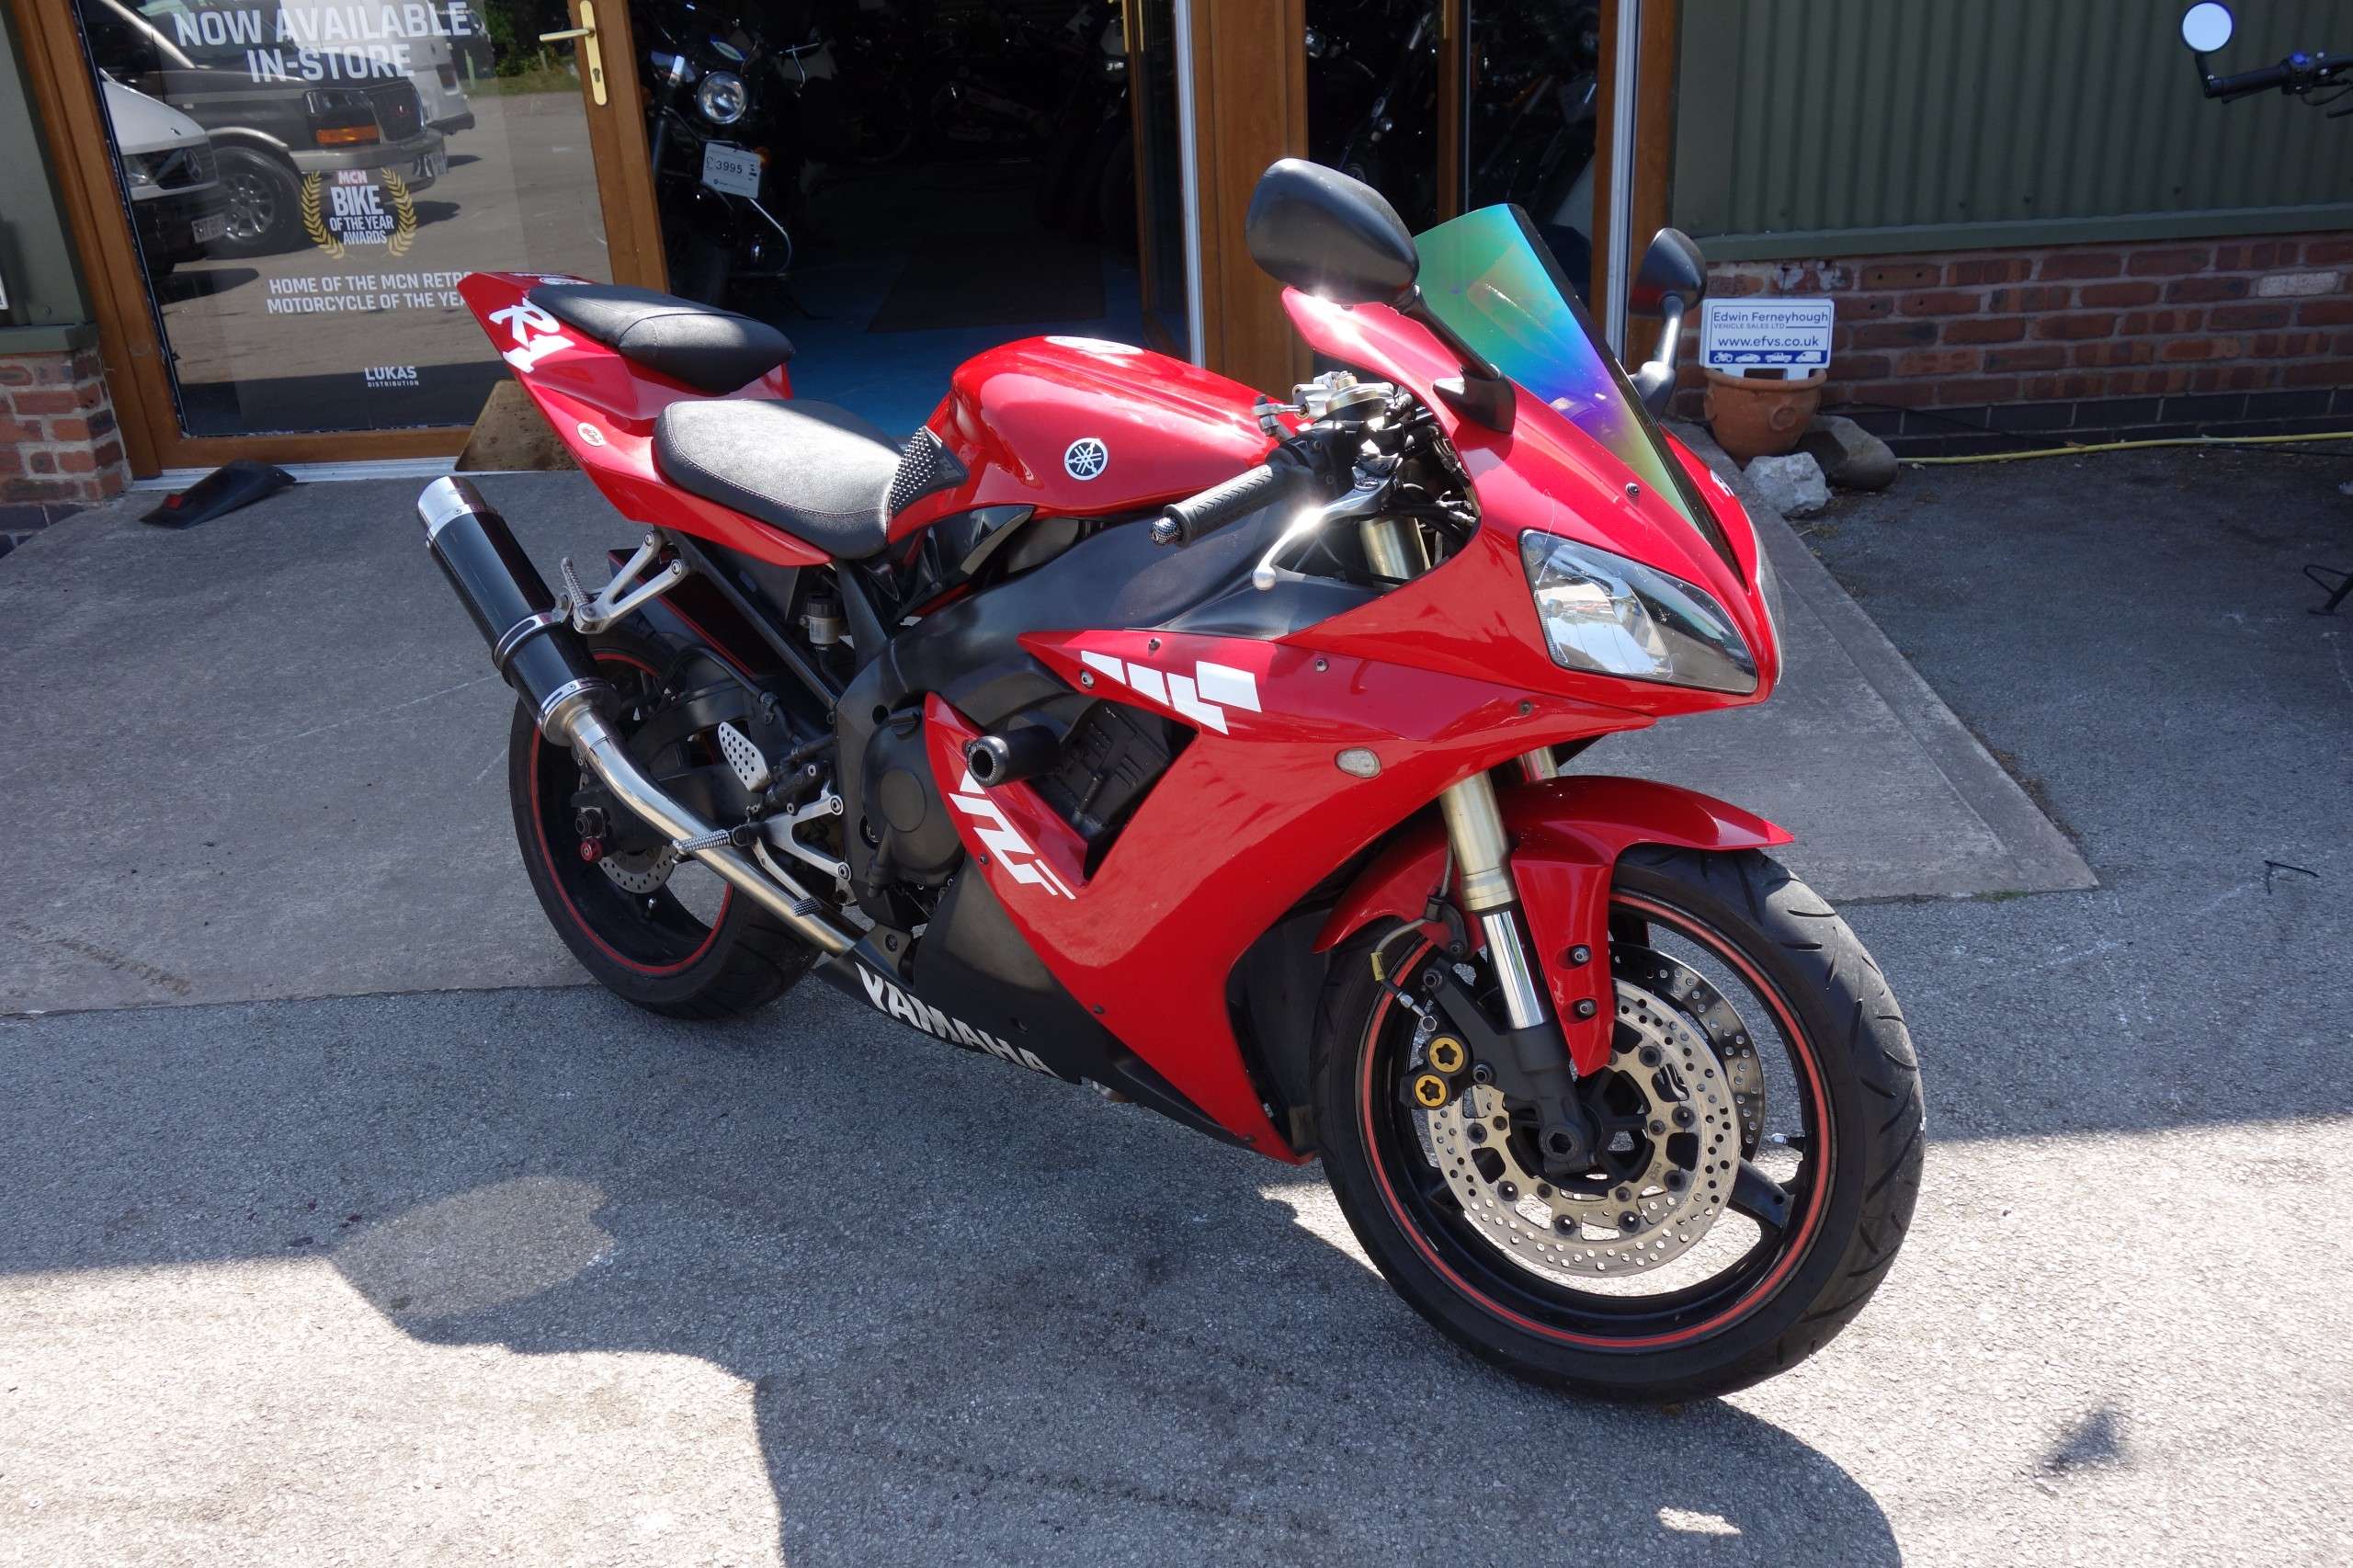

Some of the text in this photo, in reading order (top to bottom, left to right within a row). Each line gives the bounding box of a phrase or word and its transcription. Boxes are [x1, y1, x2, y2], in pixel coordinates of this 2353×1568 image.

[175, 2, 472, 46] NOW AVAILABLE
[247, 43, 415, 83] IN-STORE
[338, 170, 368, 184] MCN
[331, 185, 383, 216] BIKE
[329, 215, 394, 231] OF THE YEAR
[344, 230, 387, 245] AWARDS
[269, 271, 472, 294] HOME OF THE MCN RETR
[267, 294, 376, 313] MOTORCYCLE
[380, 294, 401, 309] OF
[404, 292, 436, 308] THE
[1714, 312, 1828, 324] Edwin Ferneyhough
[488, 297, 575, 373] R1
[1719, 335, 1819, 347] www.efvs.co.uk
[364, 366, 417, 381] LUKAS
[855, 961, 1062, 1079] YAMAHA
